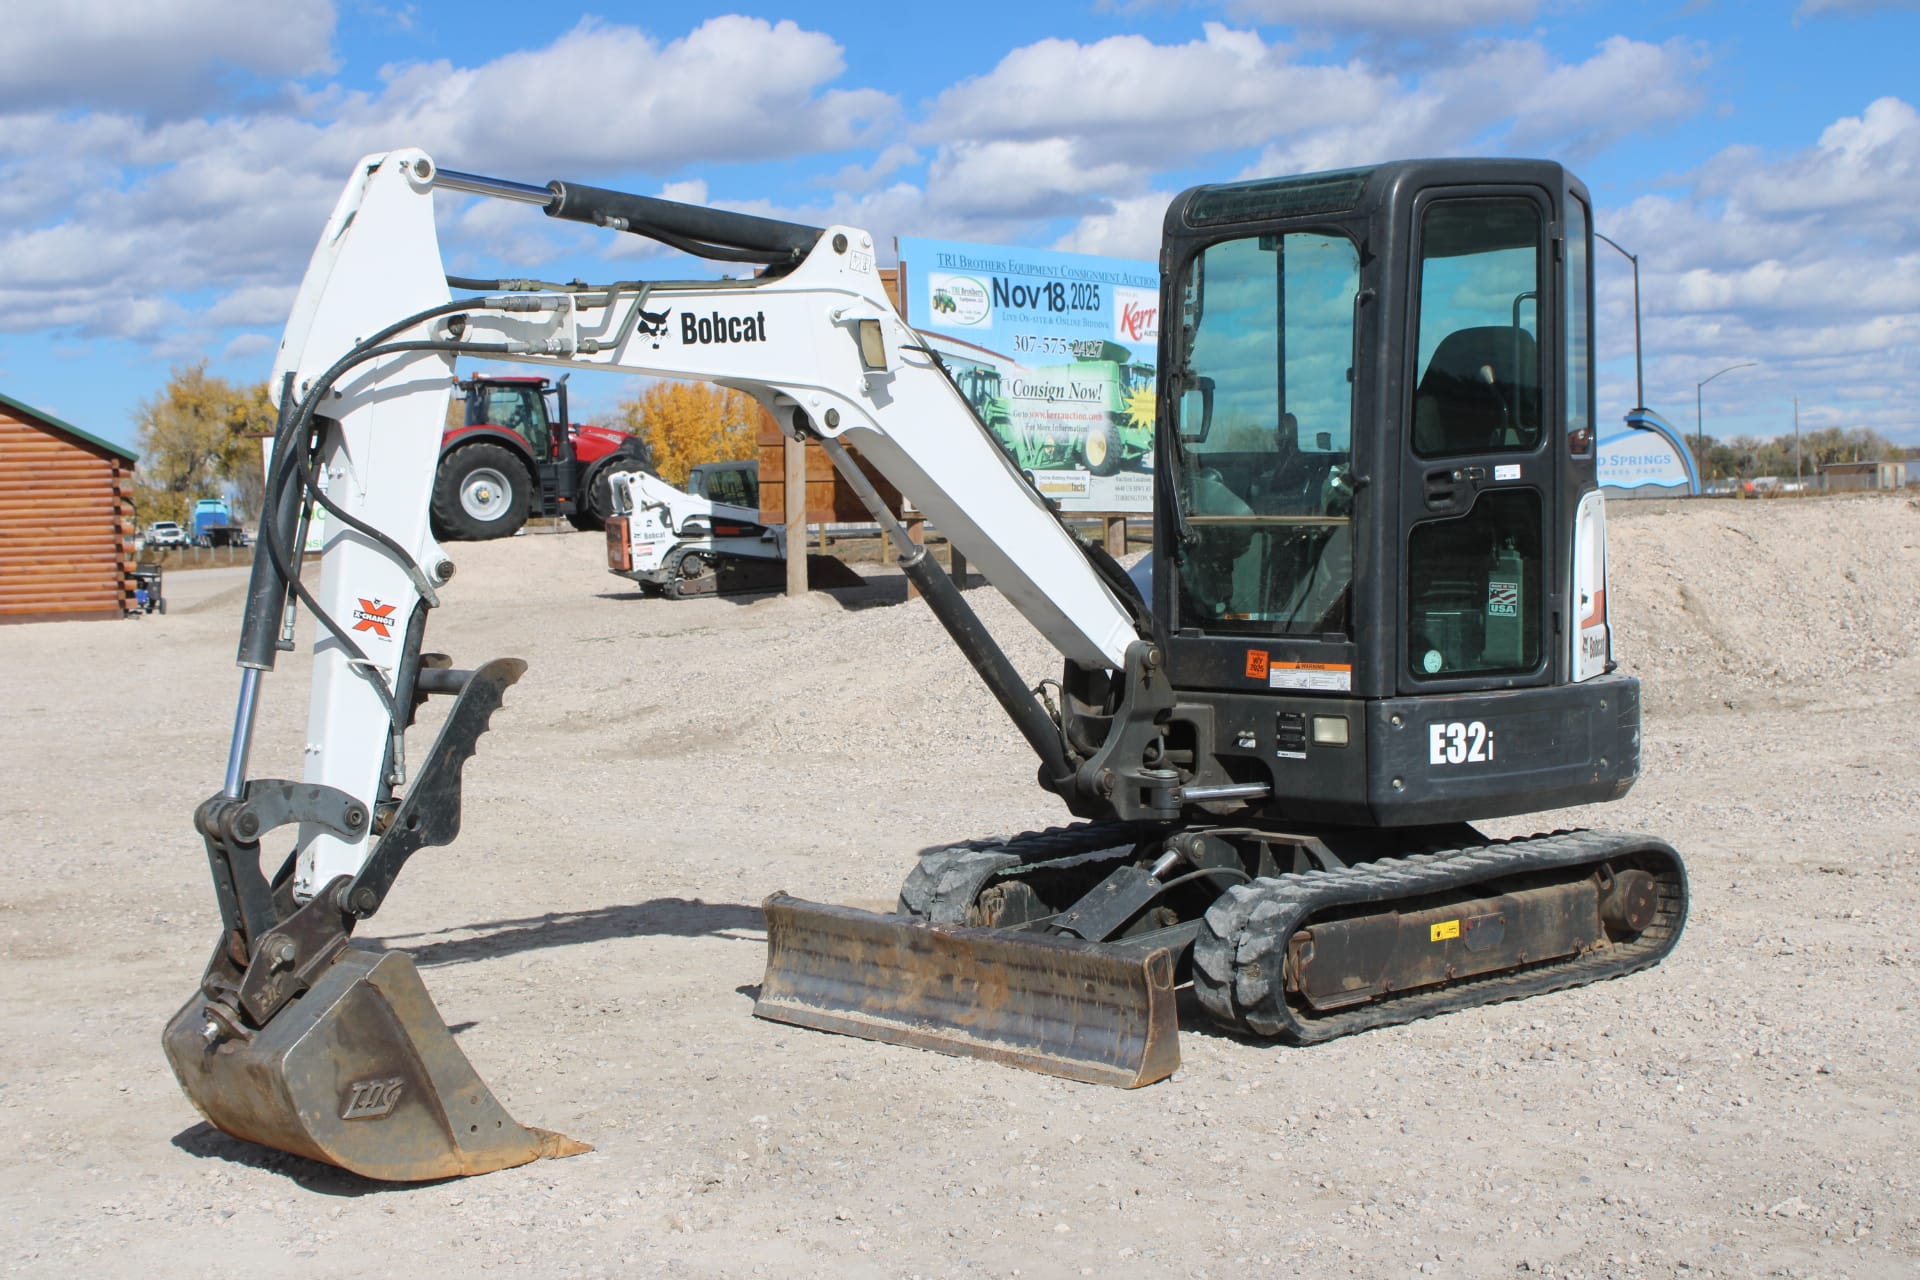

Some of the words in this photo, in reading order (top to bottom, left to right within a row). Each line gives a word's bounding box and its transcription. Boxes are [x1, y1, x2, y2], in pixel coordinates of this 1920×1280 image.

[937, 253, 957, 267] TRI
[959, 256, 1007, 272] BROTHERS
[1009, 260, 1059, 277] EQUIPMENT
[1060, 265, 1121, 283] CONSIGNMENT
[1122, 273, 1157, 287] AUCTION
[681, 311, 767, 345] Bobcat
[1002, 311, 1018, 322] LIVE
[1055, 315, 1080, 327] ONLINE
[1120, 301, 1157, 342] Kerr
[1012, 335, 1104, 358] 307-575-2427
[1012, 379, 1064, 404] Consign
[1069, 382, 1103, 401] Now!
[1610, 455, 1671, 466] SPRINGS
[1490, 604, 1514, 613] USA
[1430, 721, 1494, 765] E32i
